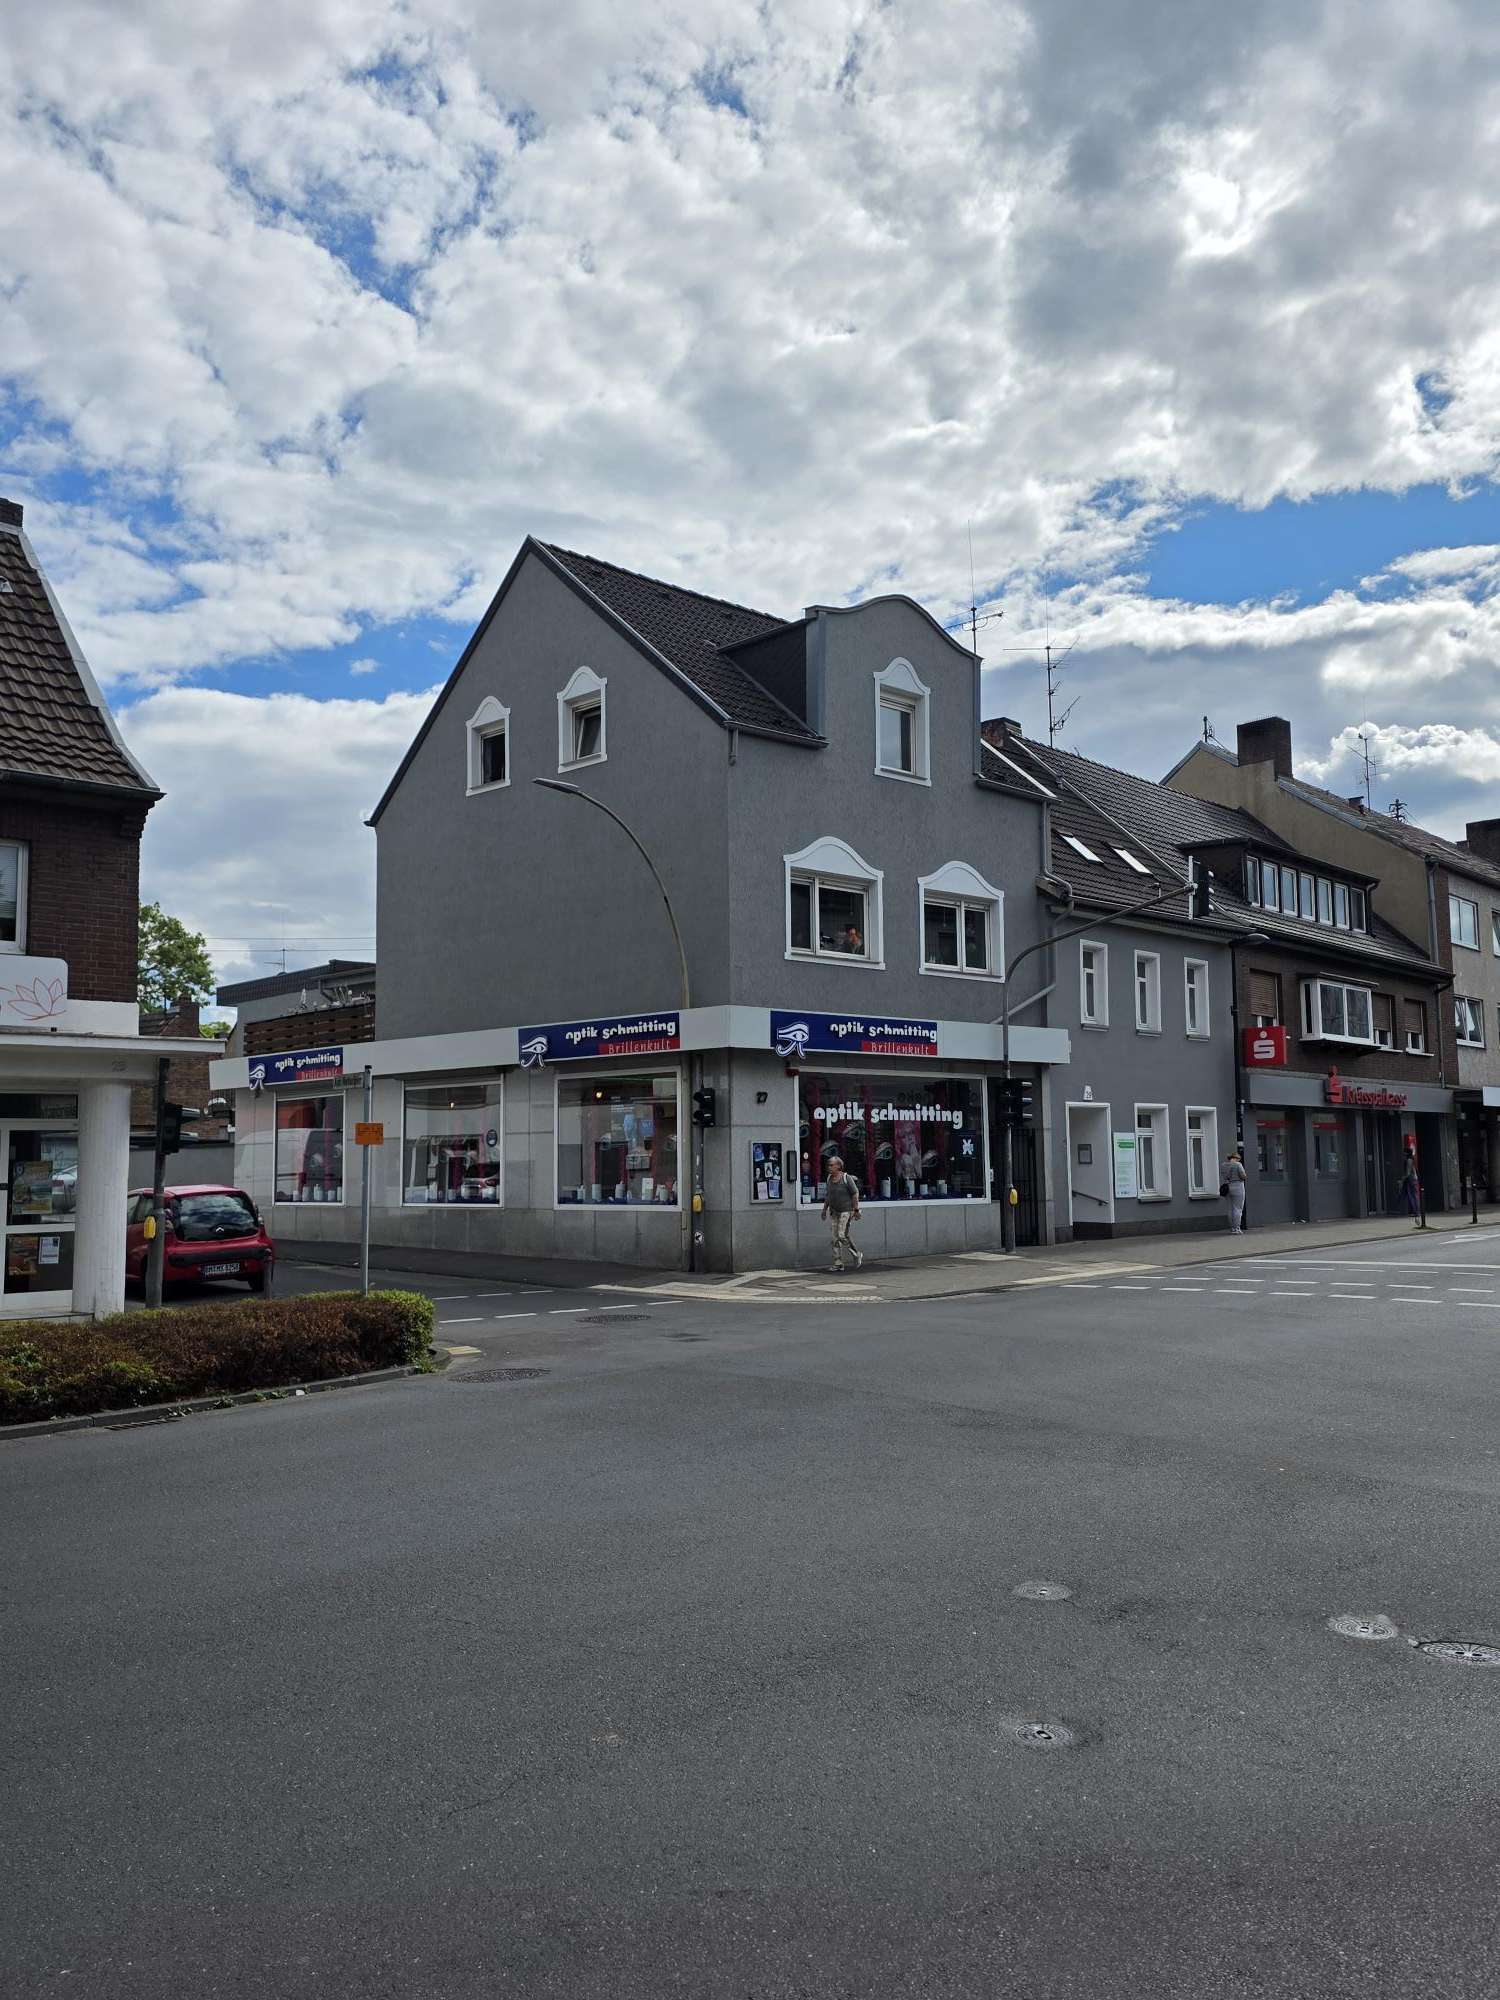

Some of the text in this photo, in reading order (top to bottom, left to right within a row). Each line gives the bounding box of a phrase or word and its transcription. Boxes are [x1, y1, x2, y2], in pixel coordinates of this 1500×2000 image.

[566, 1019, 676, 1044] optik schmitting
[830, 1021, 937, 1043] optik schmitting
[608, 1040, 671, 1055] Brillenkult
[871, 1042, 930, 1054] Brillenkult
[275, 1053, 341, 1072] optik schmitting
[813, 1101, 963, 1129] optik schmitting
